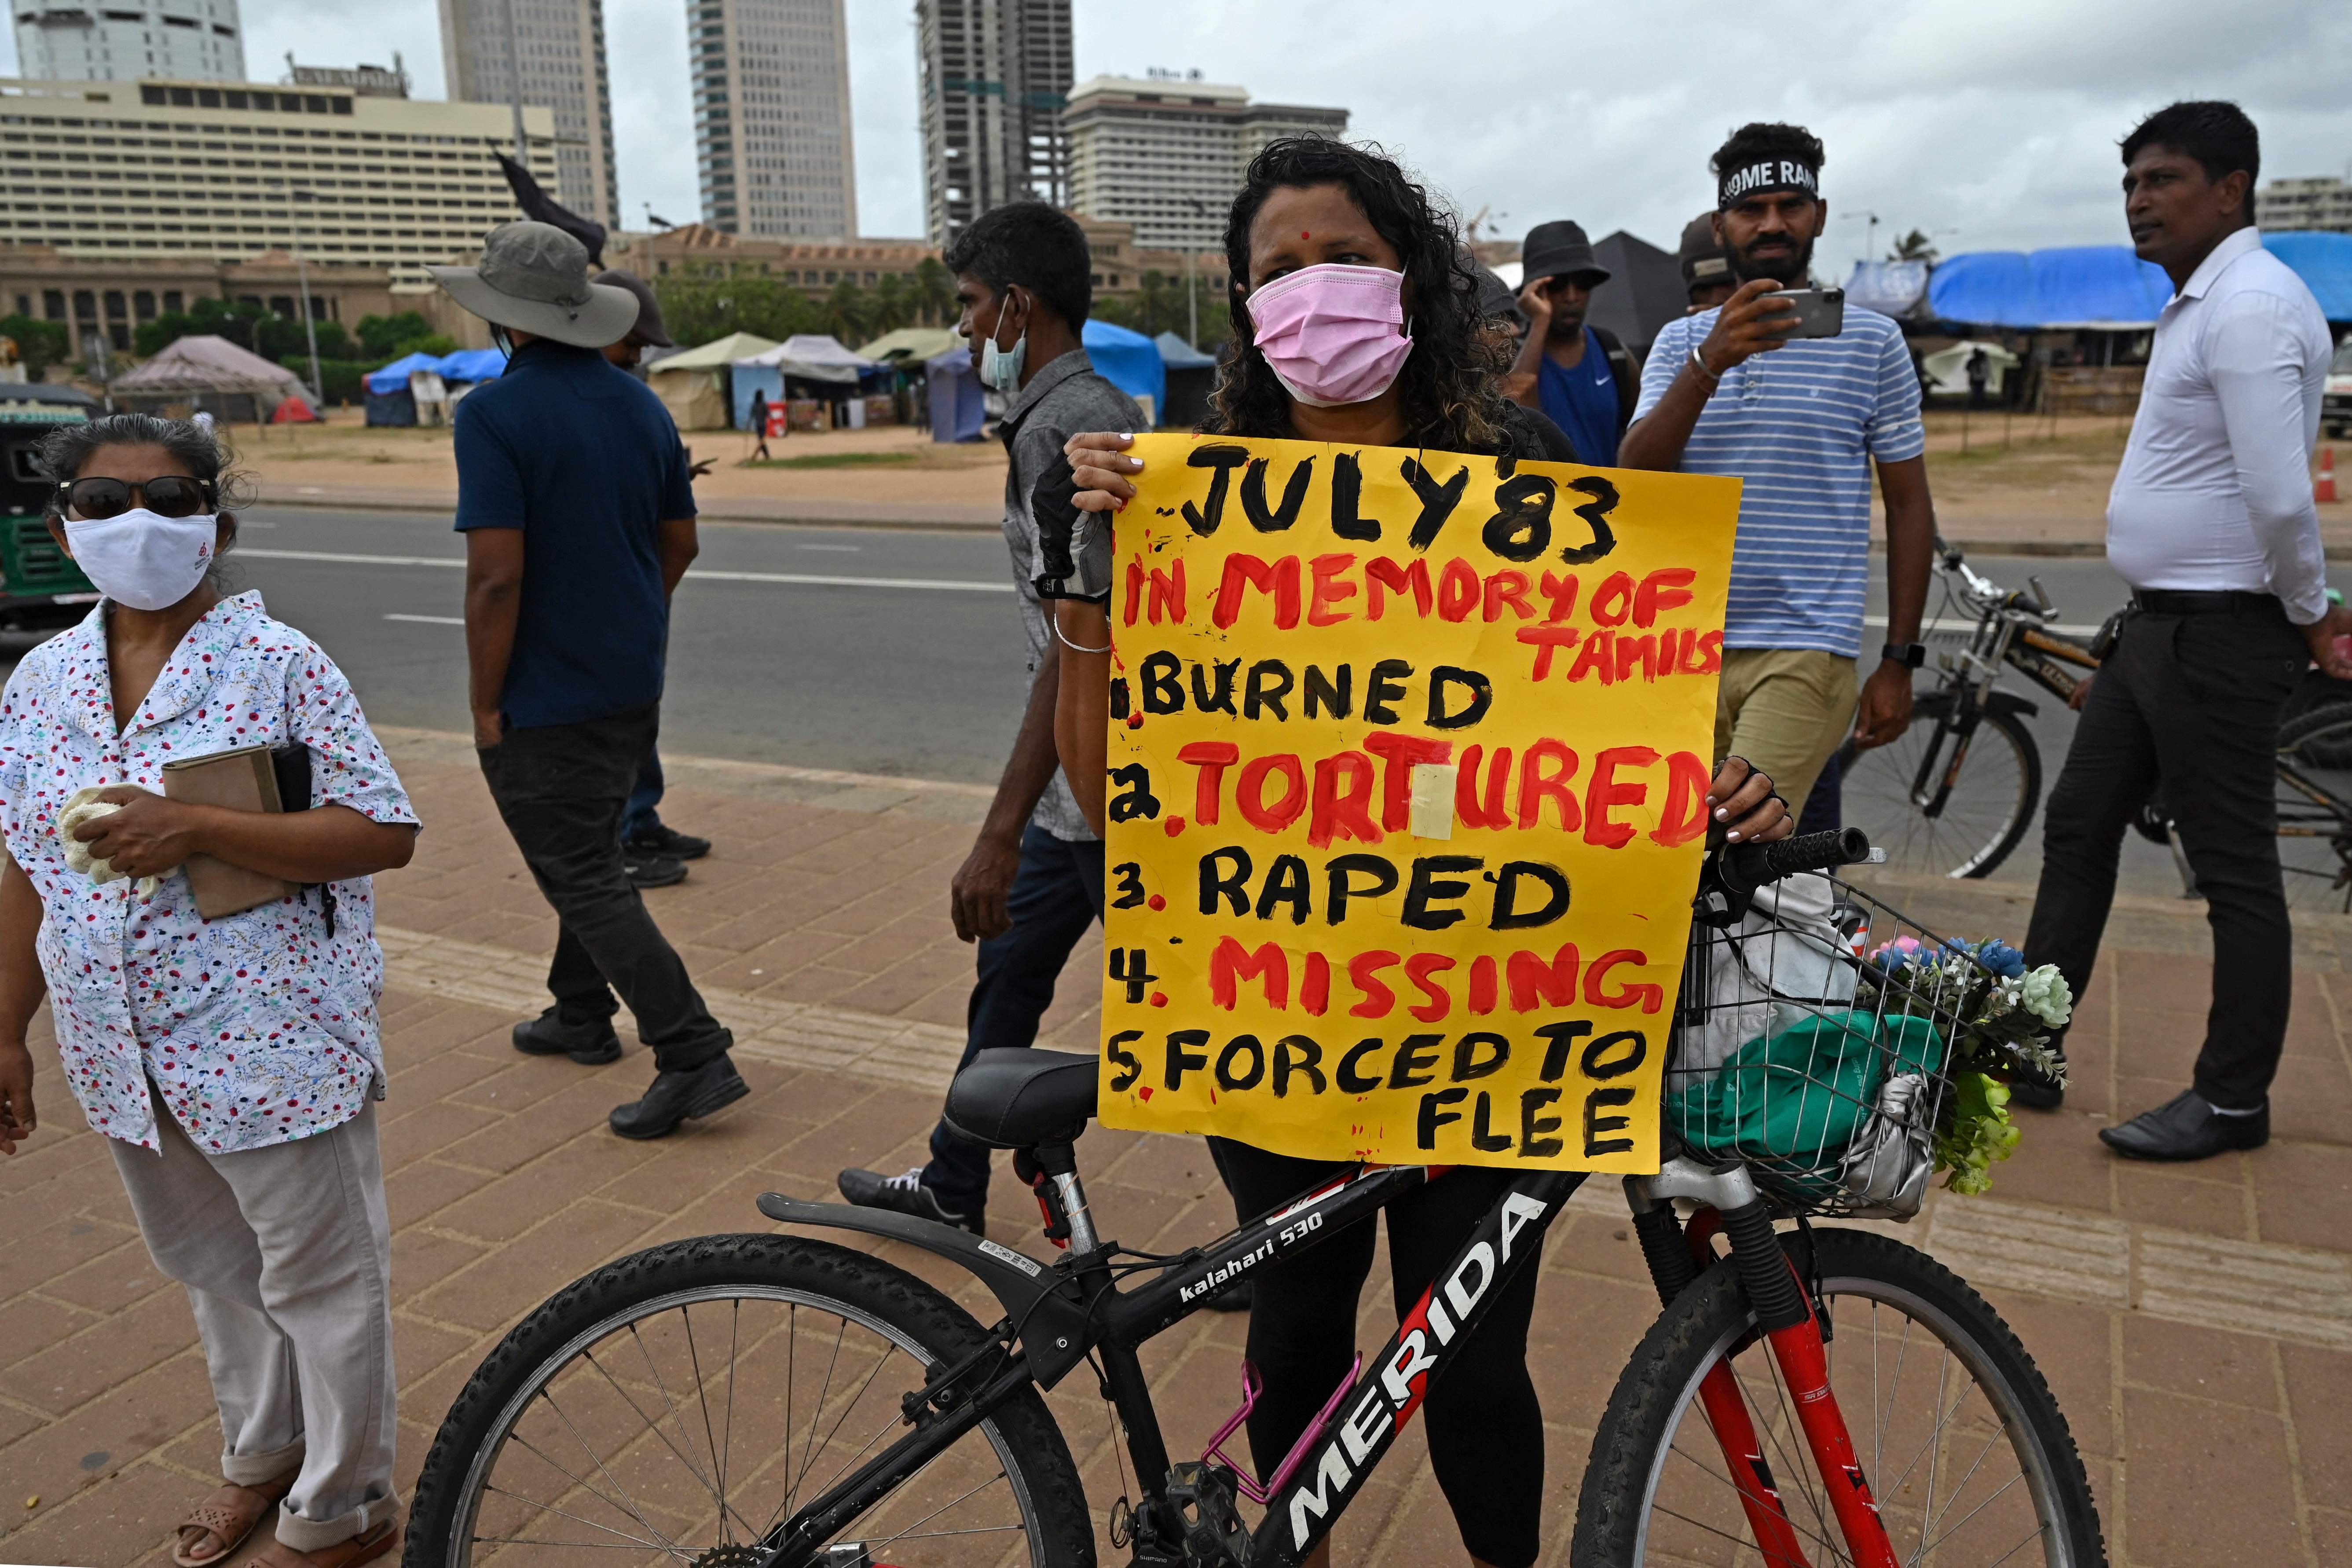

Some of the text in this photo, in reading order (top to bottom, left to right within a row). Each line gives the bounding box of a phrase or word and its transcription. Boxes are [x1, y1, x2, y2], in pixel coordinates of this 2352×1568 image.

[1181, 443, 1469, 552] JULY
[1125, 553, 1696, 630] IN MEMORY OF
[1140, 650, 1493, 729] BURNED
[1516, 627, 1724, 686] TAMILS
[1176, 731, 1712, 850] TORTURED
[1199, 846, 1571, 931] RAPED
[1209, 936, 1663, 1022] MISSING
[1164, 1029, 1511, 1098] FORCED
[1533, 1020, 1647, 1083] TO
[1417, 1088, 1636, 1158] FLEE
[1180, 1212, 1323, 1303] kalahari 530
[1289, 1191, 1548, 1553] MERIDA
[1139, 1555, 1167, 1563] SHIMANO
